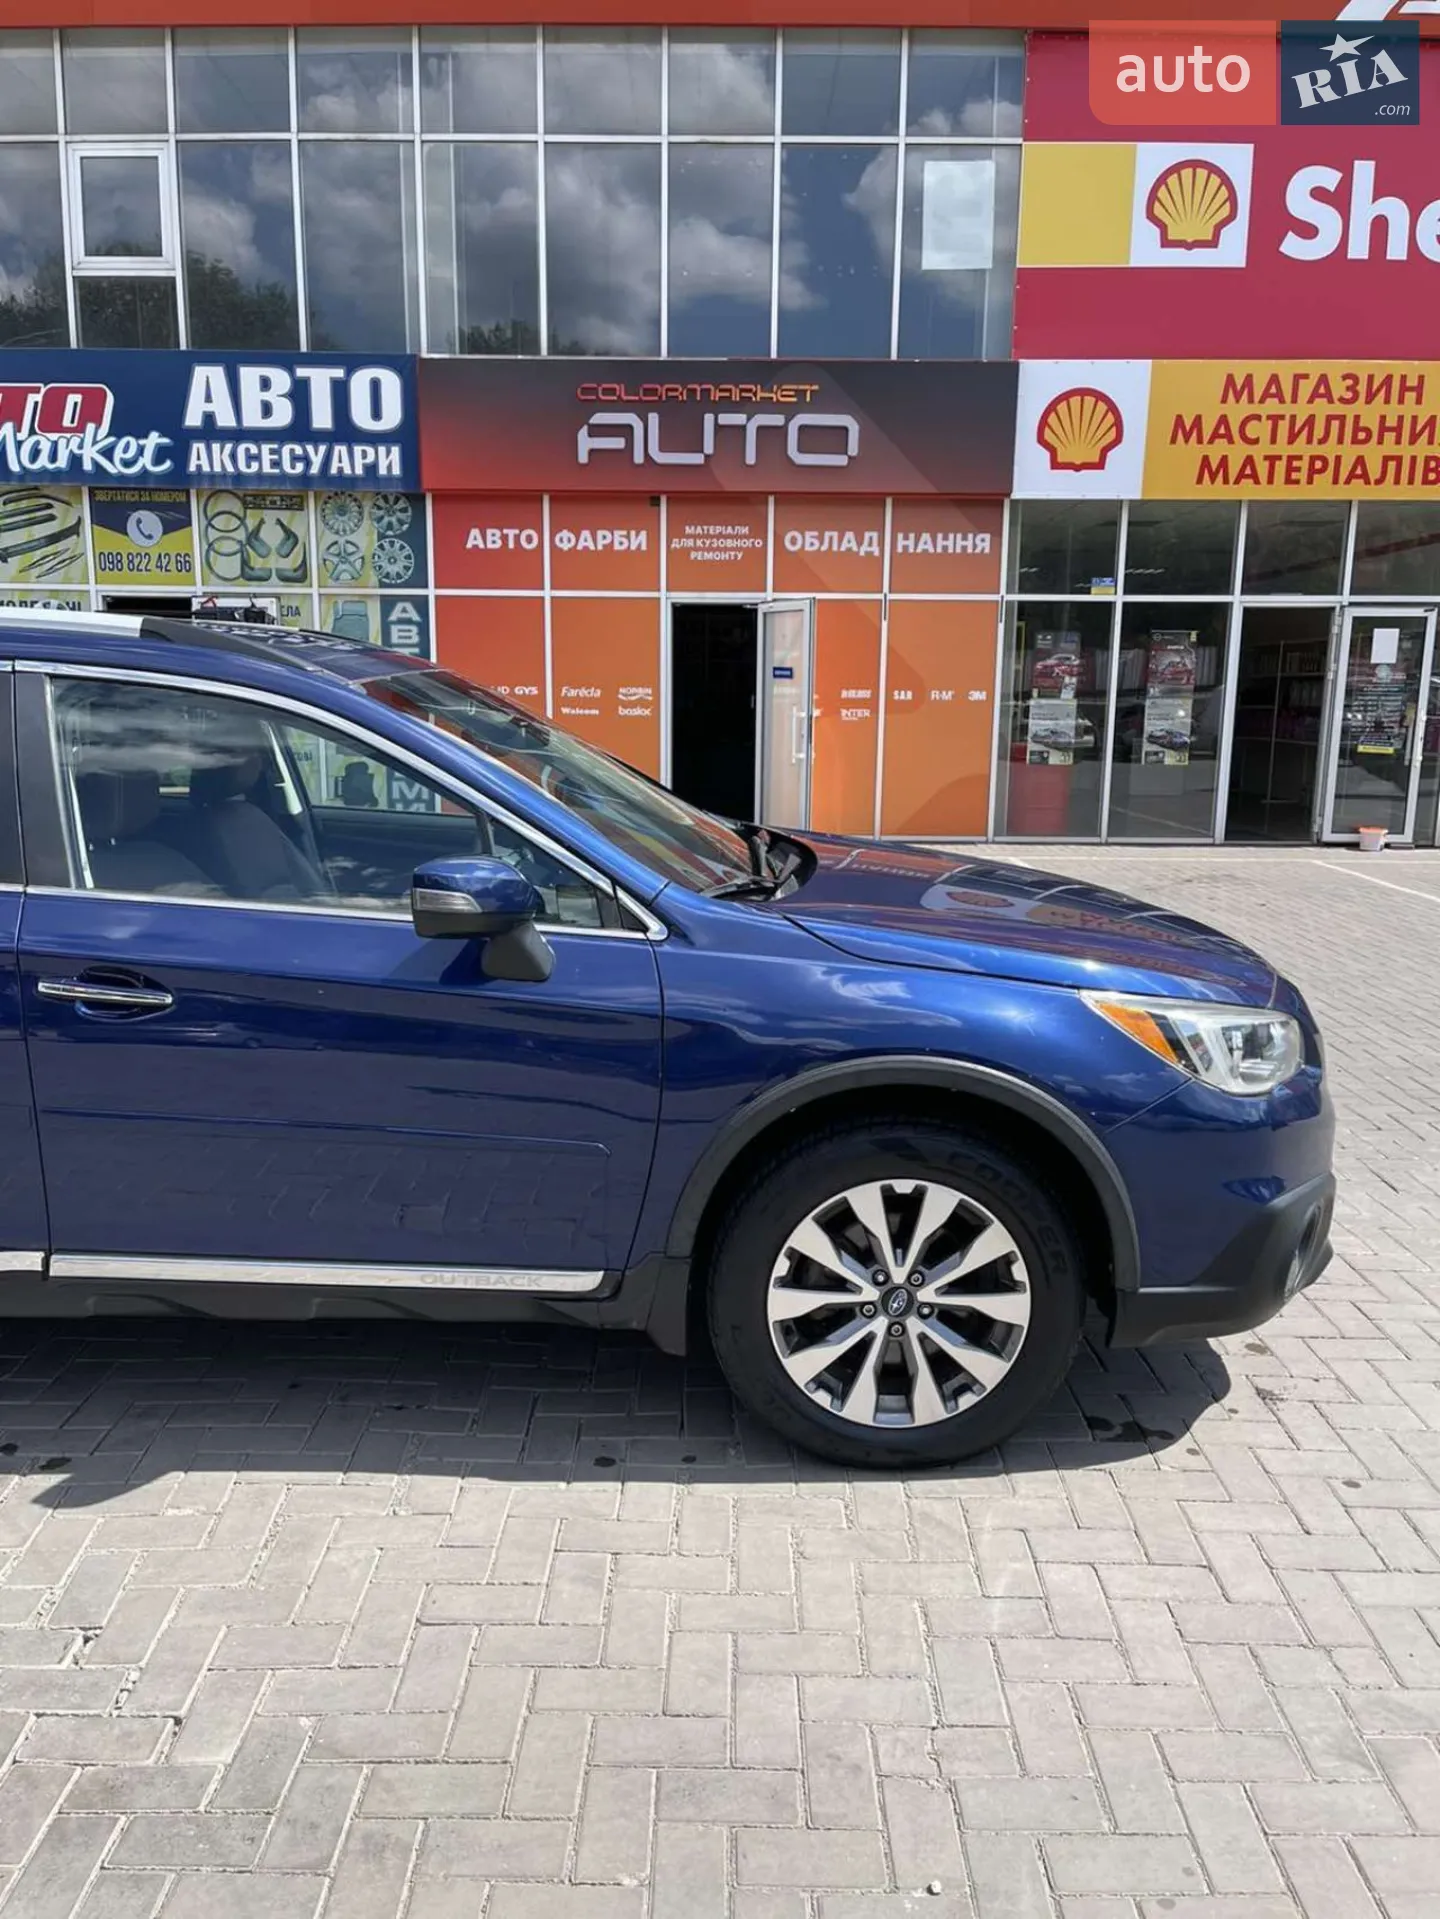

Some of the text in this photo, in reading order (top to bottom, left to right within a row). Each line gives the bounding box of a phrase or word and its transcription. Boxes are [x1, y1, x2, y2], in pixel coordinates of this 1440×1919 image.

[183, 365, 402, 431] АВТО
[576, 383, 820, 402] COLORMARKET
[1220, 373, 1425, 406] МАГАЗИН
[576, 412, 860, 467] AUTO
[1168, 414, 1440, 446] МАСТИЛЬНИ
[187, 442, 401, 476] АКСЕСУАРИ
[1195, 454, 1440, 486] МАТЕРІАЛІВ
[466, 527, 648, 553] АВТО ФАРБИ
[684, 525, 749, 535] МАТЕРІАЛИ
[671, 538, 763, 549] ДЛЯ КУЗОВНОГО
[690, 550, 743, 560] РЕМОНТУ
[784, 531, 991, 557] ОБЛАД НАННЯ
[98, 551, 192, 573] 098 822 42 66
[420, 1274, 543, 1288] OUTBACK
